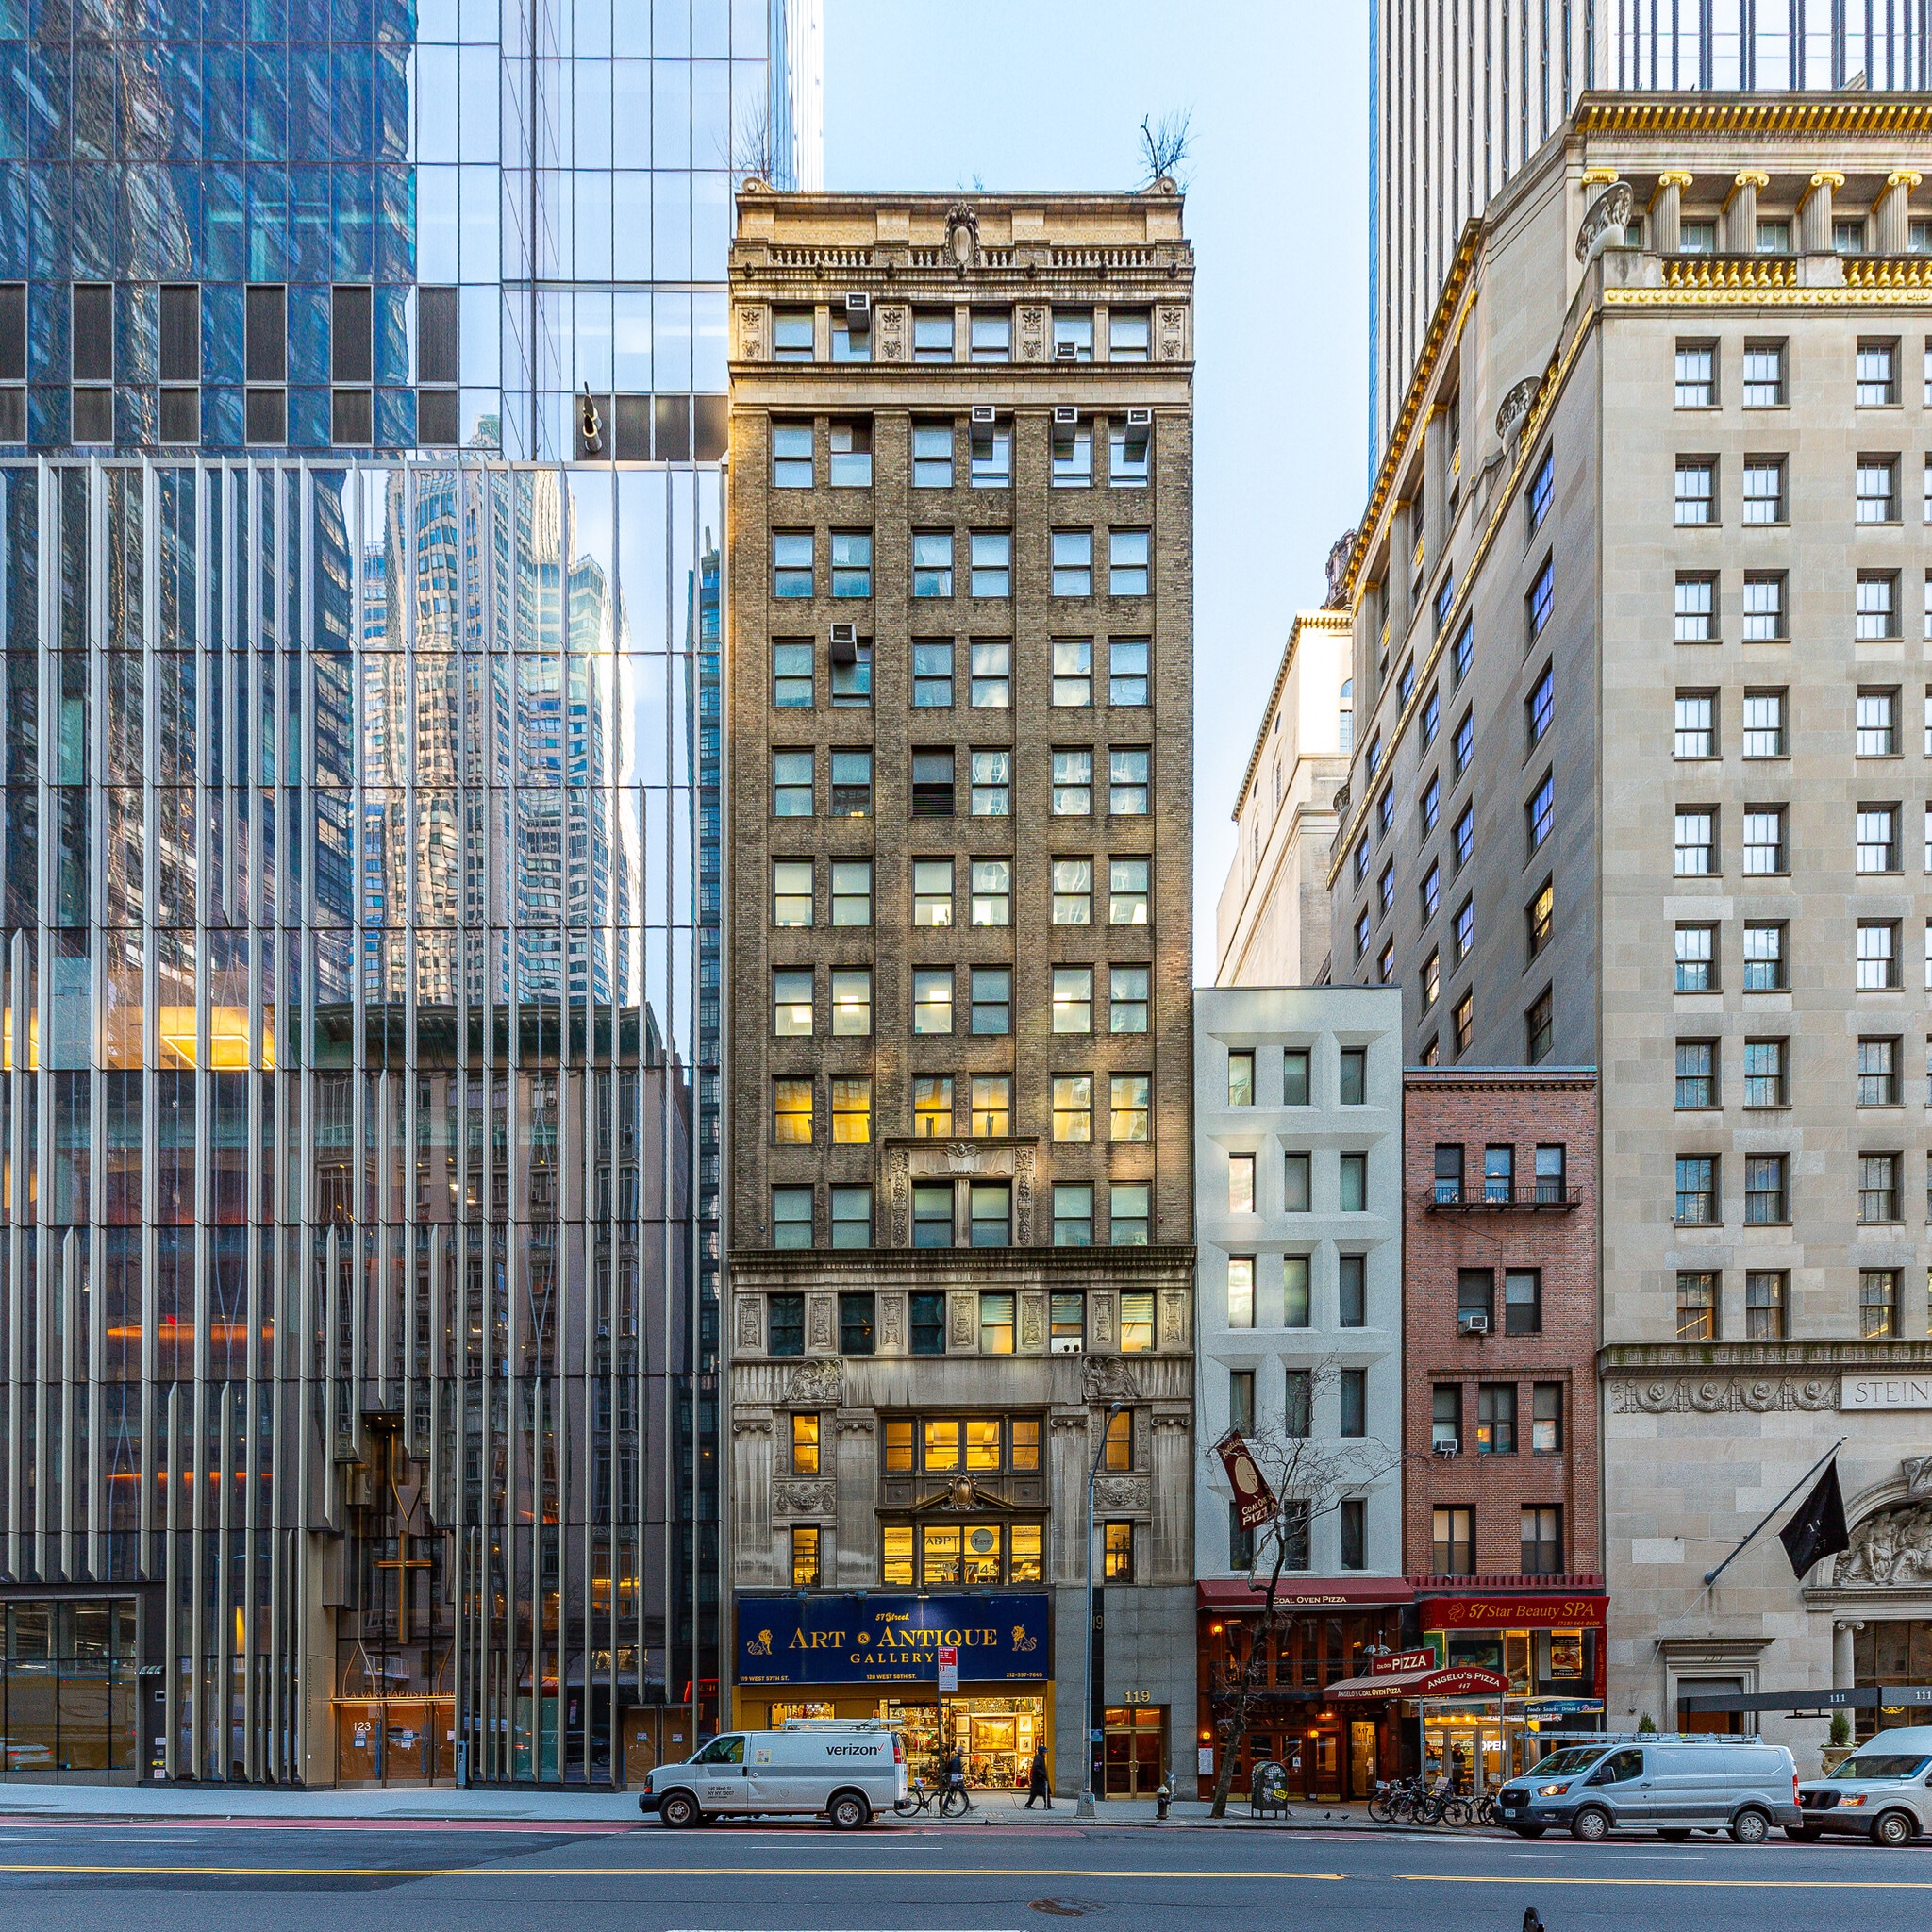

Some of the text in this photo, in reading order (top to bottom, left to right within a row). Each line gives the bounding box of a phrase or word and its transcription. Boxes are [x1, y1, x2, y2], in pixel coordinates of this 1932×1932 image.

[1855, 1381, 1932, 1403] STEIN
[1241, 1503, 1259, 1515] COAL
[966, 1563, 998, 1576] 7145
[1468, 1601, 1595, 1620] 57 Star Beauty SPA
[788, 1627, 846, 1649] ART
[876, 1625, 998, 1648] ANTIQUE
[850, 1652, 934, 1664] GALLERY
[1391, 1654, 1427, 1671] PIZZA
[1427, 1671, 1500, 1690] ANGELO'S PIZZA
[344, 1690, 384, 1699] CALVARY
[386, 1690, 423, 1698] BAPTIST
[1124, 1690, 1151, 1703] 119
[1337, 1690, 1358, 1698] ANGELO'S
[1372, 1688, 1386, 1696] OVEN
[1386, 1687, 1402, 1695] PIZZA
[1829, 1693, 1846, 1703] 111
[1915, 1690, 1932, 1700] 111
[1326, 1703, 1366, 1712] PIZZA
[352, 1722, 372, 1731] 123
[825, 1743, 878, 1756] verizon
